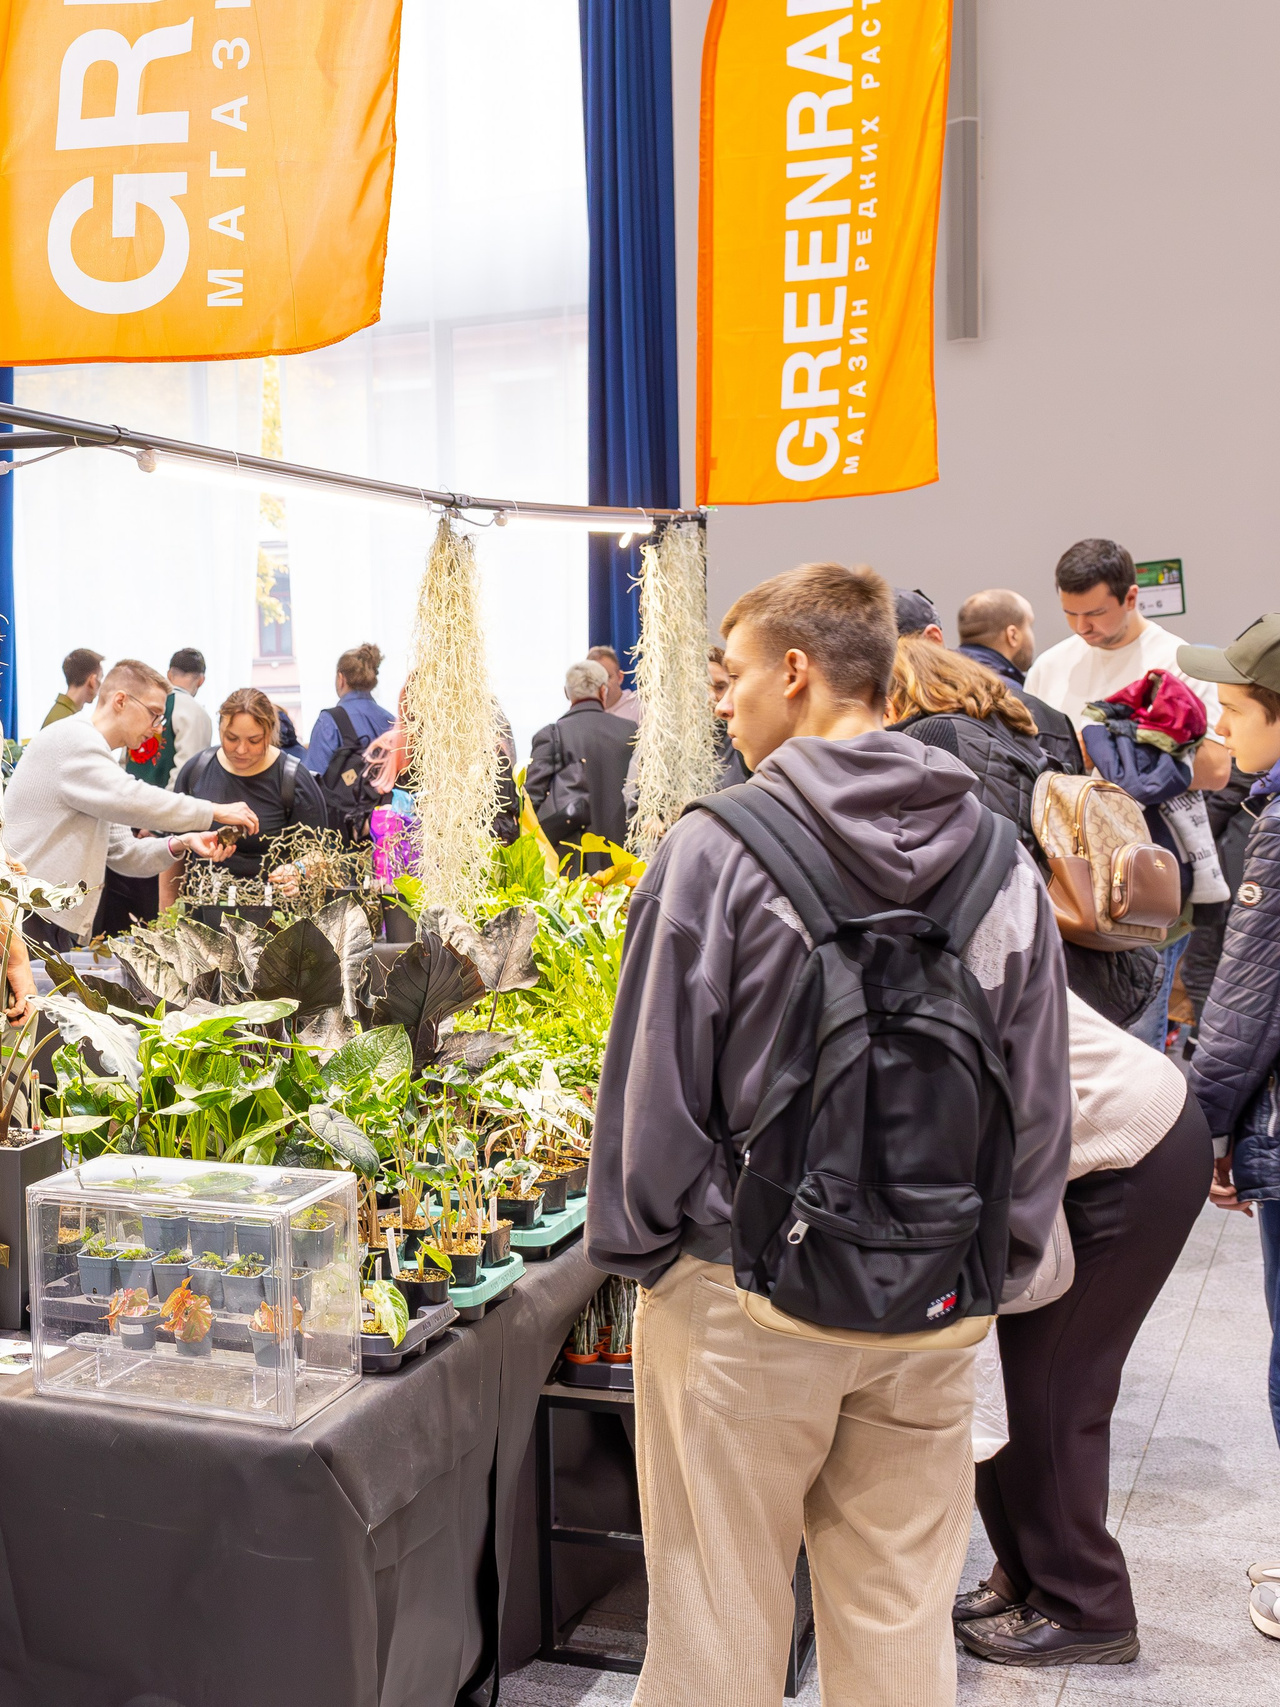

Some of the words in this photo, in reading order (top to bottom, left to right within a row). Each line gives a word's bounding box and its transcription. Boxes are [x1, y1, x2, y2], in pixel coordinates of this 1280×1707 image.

[48, 0, 194, 314] GR
[207, 0, 251, 306] МАГАЗ
[843, 298, 868, 475] МАГАЗИН
[856, 117, 878, 271] РЕДКИХ
